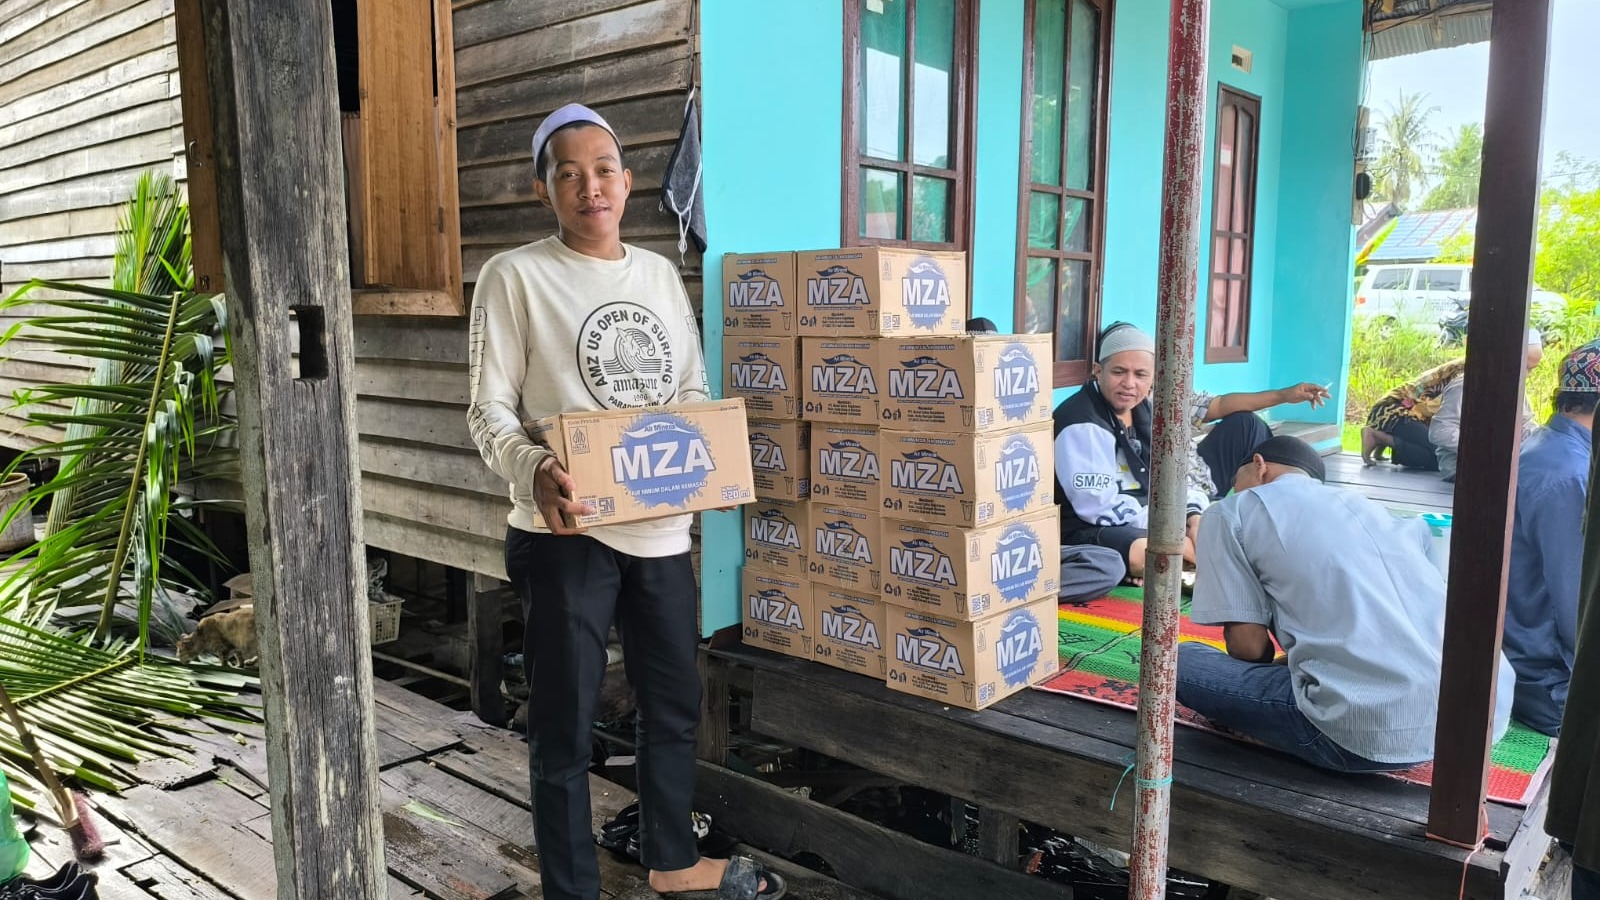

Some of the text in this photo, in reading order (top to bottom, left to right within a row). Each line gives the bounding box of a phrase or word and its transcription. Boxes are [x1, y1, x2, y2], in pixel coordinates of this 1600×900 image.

[729, 281, 785, 307] MZA
[807, 276, 871, 305] MZA
[902, 276, 951, 306] MZA
[587, 309, 673, 387] AMZ US OPEN OF SURFING
[731, 362, 788, 391] MZA
[811, 365, 878, 394] MZA
[889, 369, 964, 399] MZA
[993, 365, 1040, 399] MZA
[610, 438, 716, 484] MZA
[748, 443, 787, 471] ZA
[819, 449, 880, 480] MZA
[995, 454, 1040, 492] MZA
[660, 485, 680, 493] DALAM
[891, 459, 964, 494] MZA
[1073, 473, 1113, 490] SMAR
[598, 498, 616, 512] SNI
[721, 489, 739, 501] 220
[751, 516, 801, 549] MZA
[816, 527, 872, 564] MZA
[890, 546, 958, 586] MZA
[990, 543, 1044, 584] MZA
[749, 594, 804, 630] MZA
[822, 610, 881, 649] MZA
[896, 633, 965, 676] MZA
[995, 626, 1043, 671] MZA
